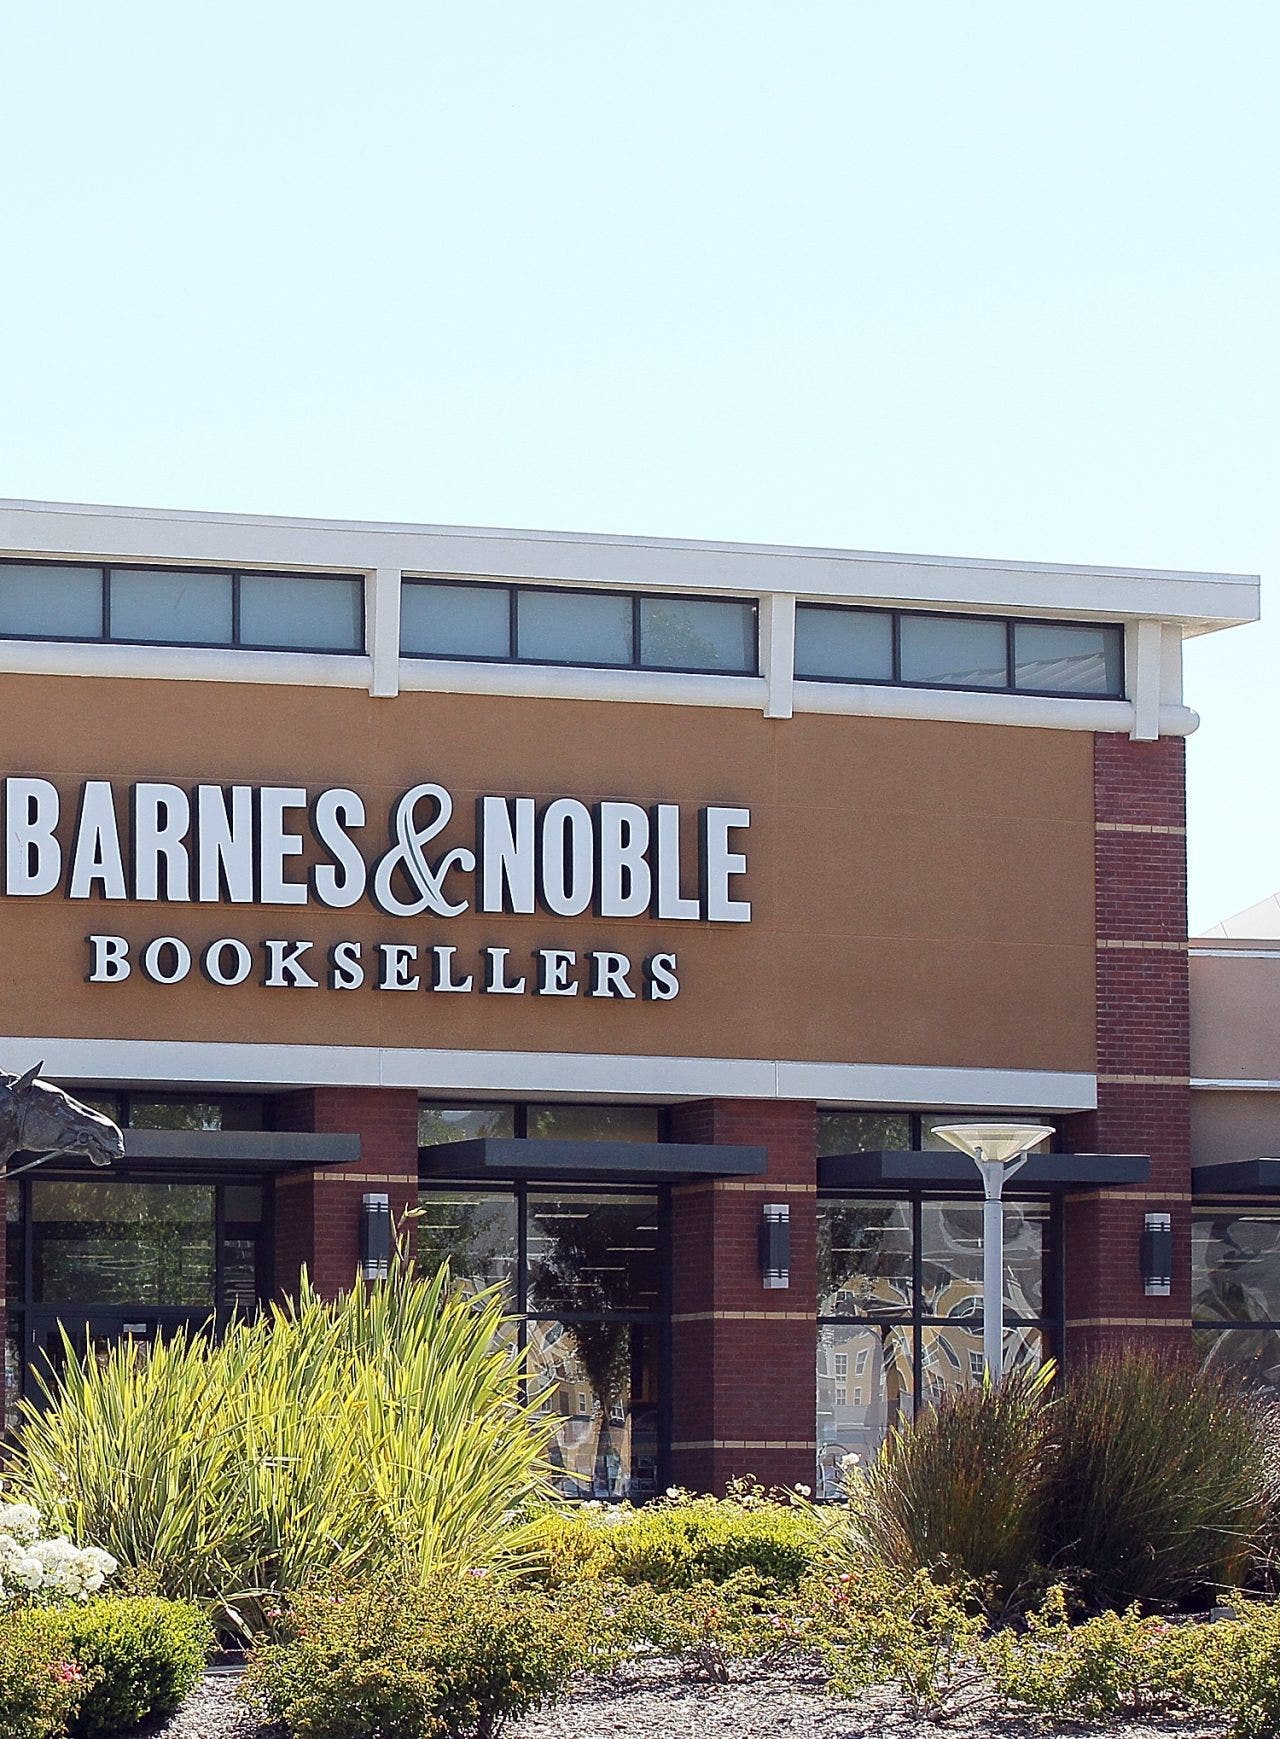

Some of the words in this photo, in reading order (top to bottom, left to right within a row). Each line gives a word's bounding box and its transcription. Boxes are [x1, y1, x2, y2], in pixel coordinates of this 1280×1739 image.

[5, 776, 367, 907] BARNES
[482, 795, 752, 923] NOBLE
[89, 935, 681, 1001] BOOKSELLERS
